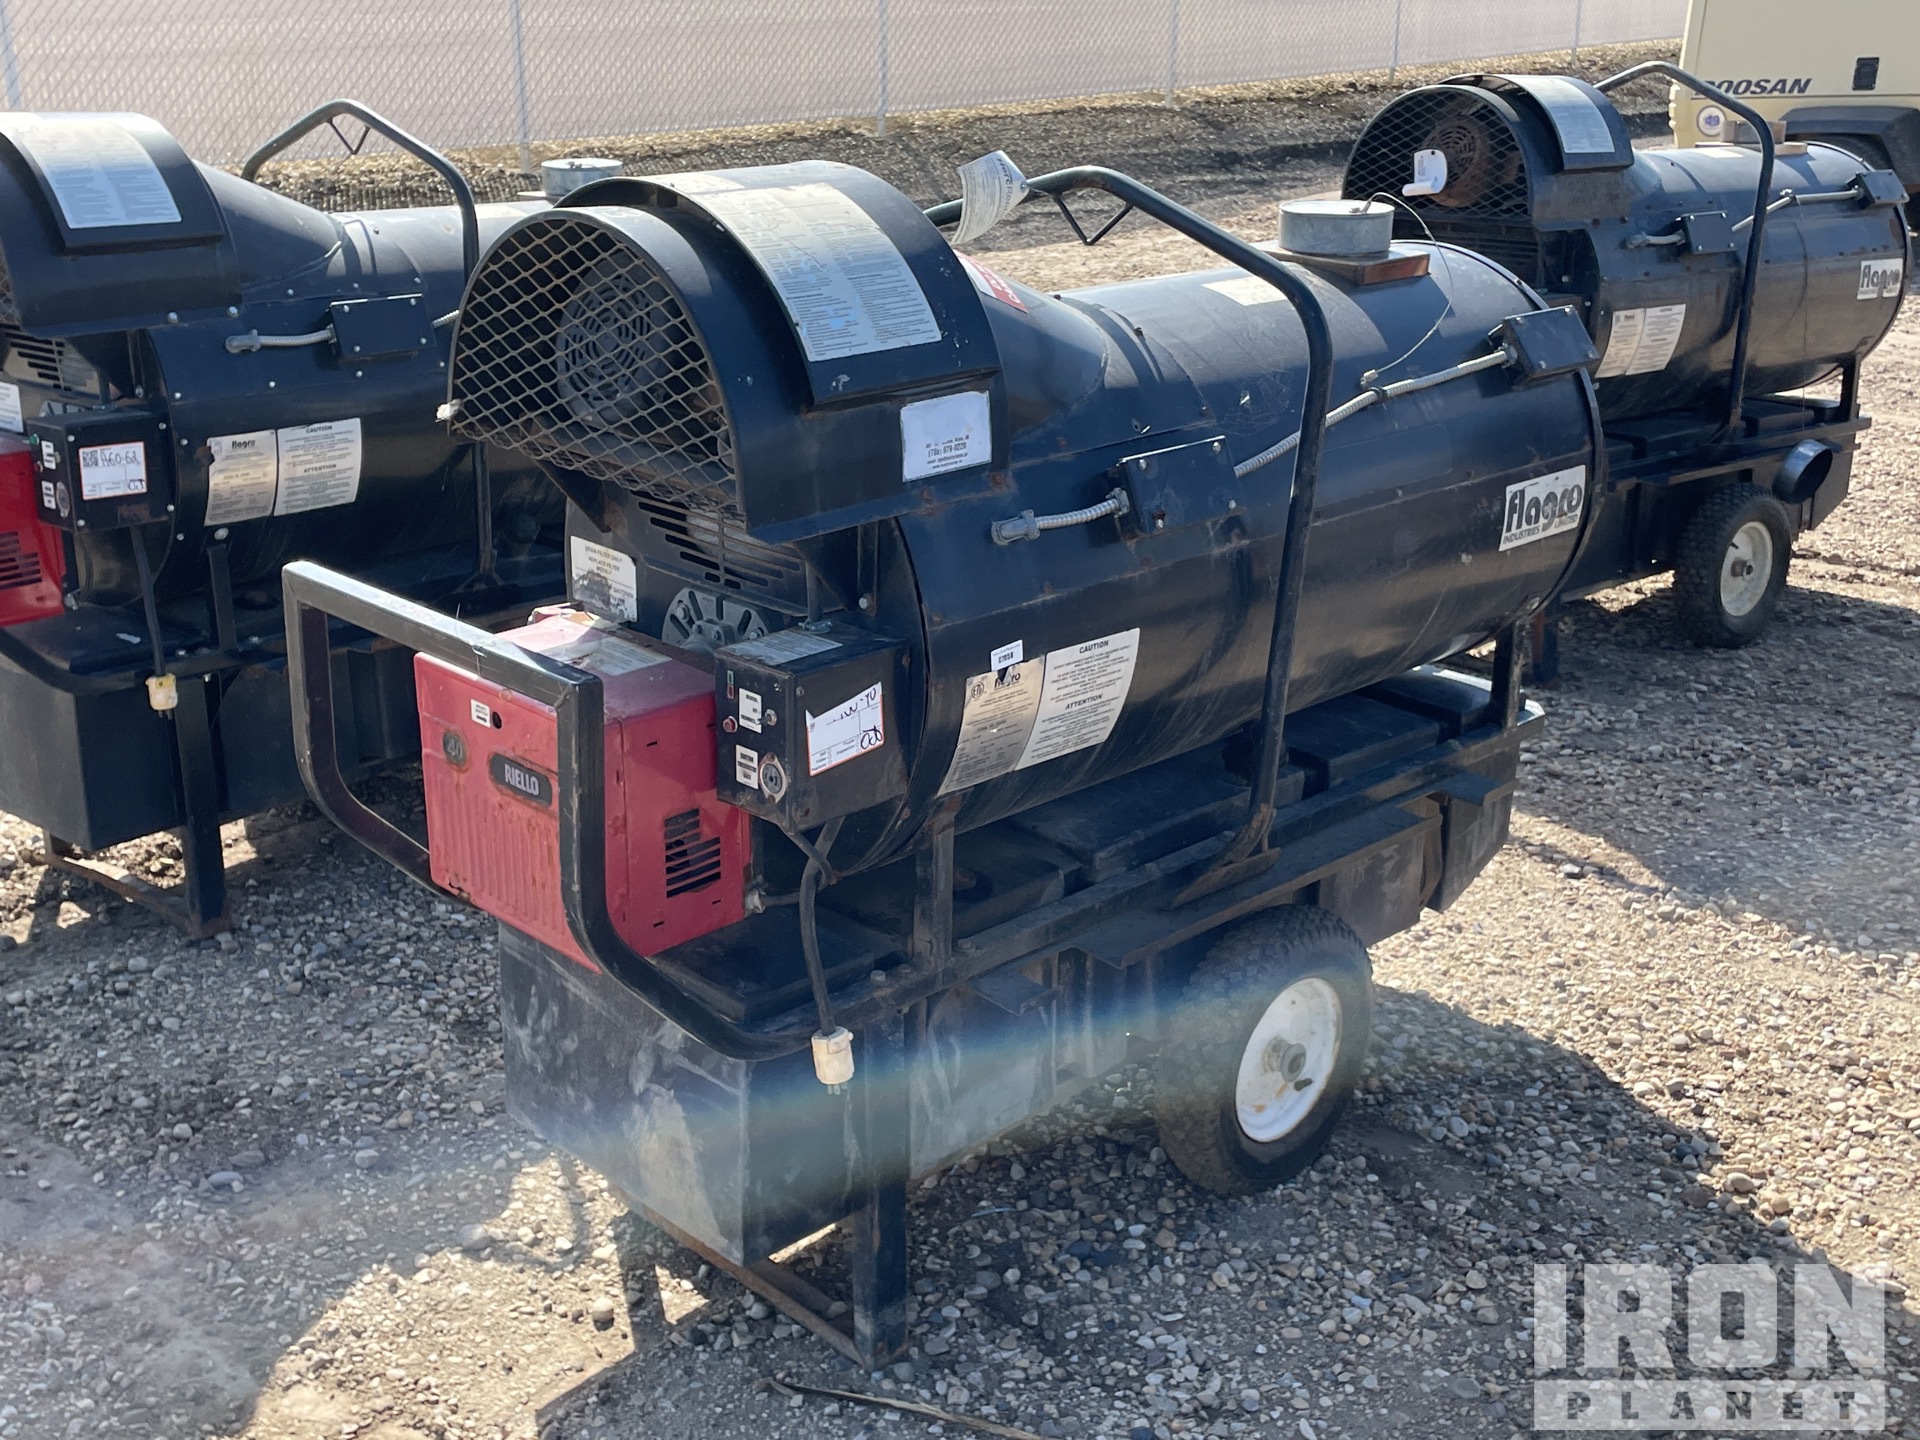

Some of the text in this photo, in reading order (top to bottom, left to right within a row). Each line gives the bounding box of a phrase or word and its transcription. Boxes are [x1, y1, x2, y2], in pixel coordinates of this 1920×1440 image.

[1696, 79, 1812, 95] OOSAN
[1505, 484, 1583, 533] flagro
[1079, 639, 1109, 654] CAUTION
[1065, 693, 1103, 710] ATTENTION
[504, 763, 539, 796] RIELLO
